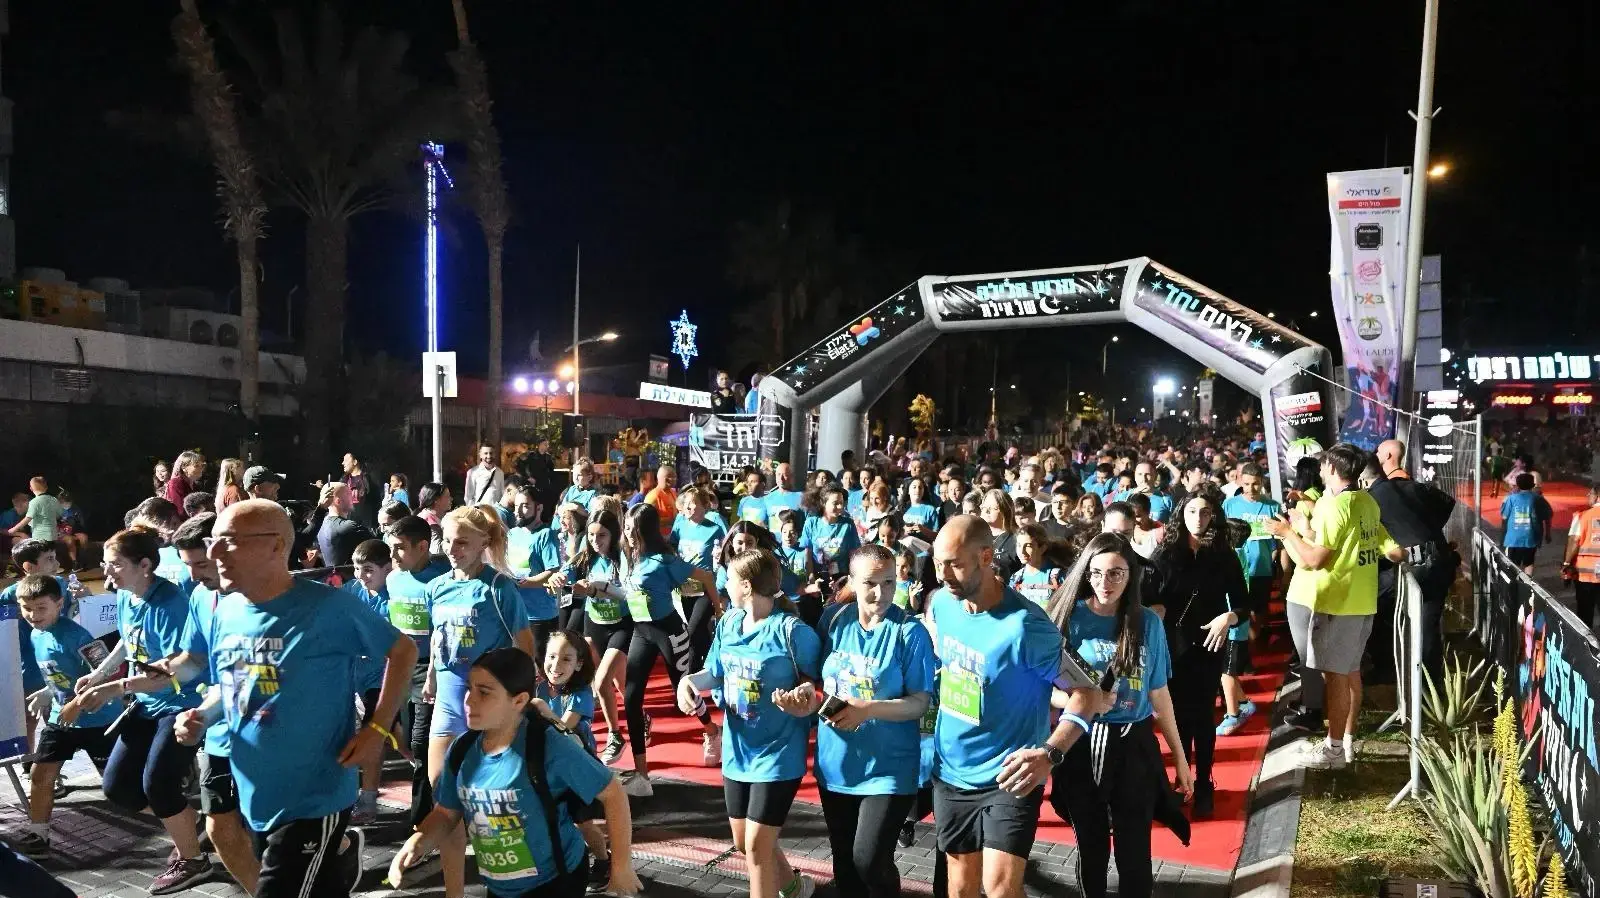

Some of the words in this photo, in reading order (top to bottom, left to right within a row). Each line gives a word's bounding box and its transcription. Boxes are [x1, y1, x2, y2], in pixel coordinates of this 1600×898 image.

[1346, 188, 1381, 197] עזריאלי
[976, 281, 1028, 300] הלילה
[1031, 278, 1076, 299] מרוץ
[1164, 282, 1200, 312] יחד
[1014, 298, 1037, 316] של
[1355, 292, 1385, 305] באלי
[978, 301, 1014, 318] אילת
[1197, 304, 1253, 346] רצים
[825, 330, 852, 351] אילת
[827, 343, 850, 361] Eilat
[1523, 351, 1591, 379] שלמה
[652, 386, 686, 403] אילת
